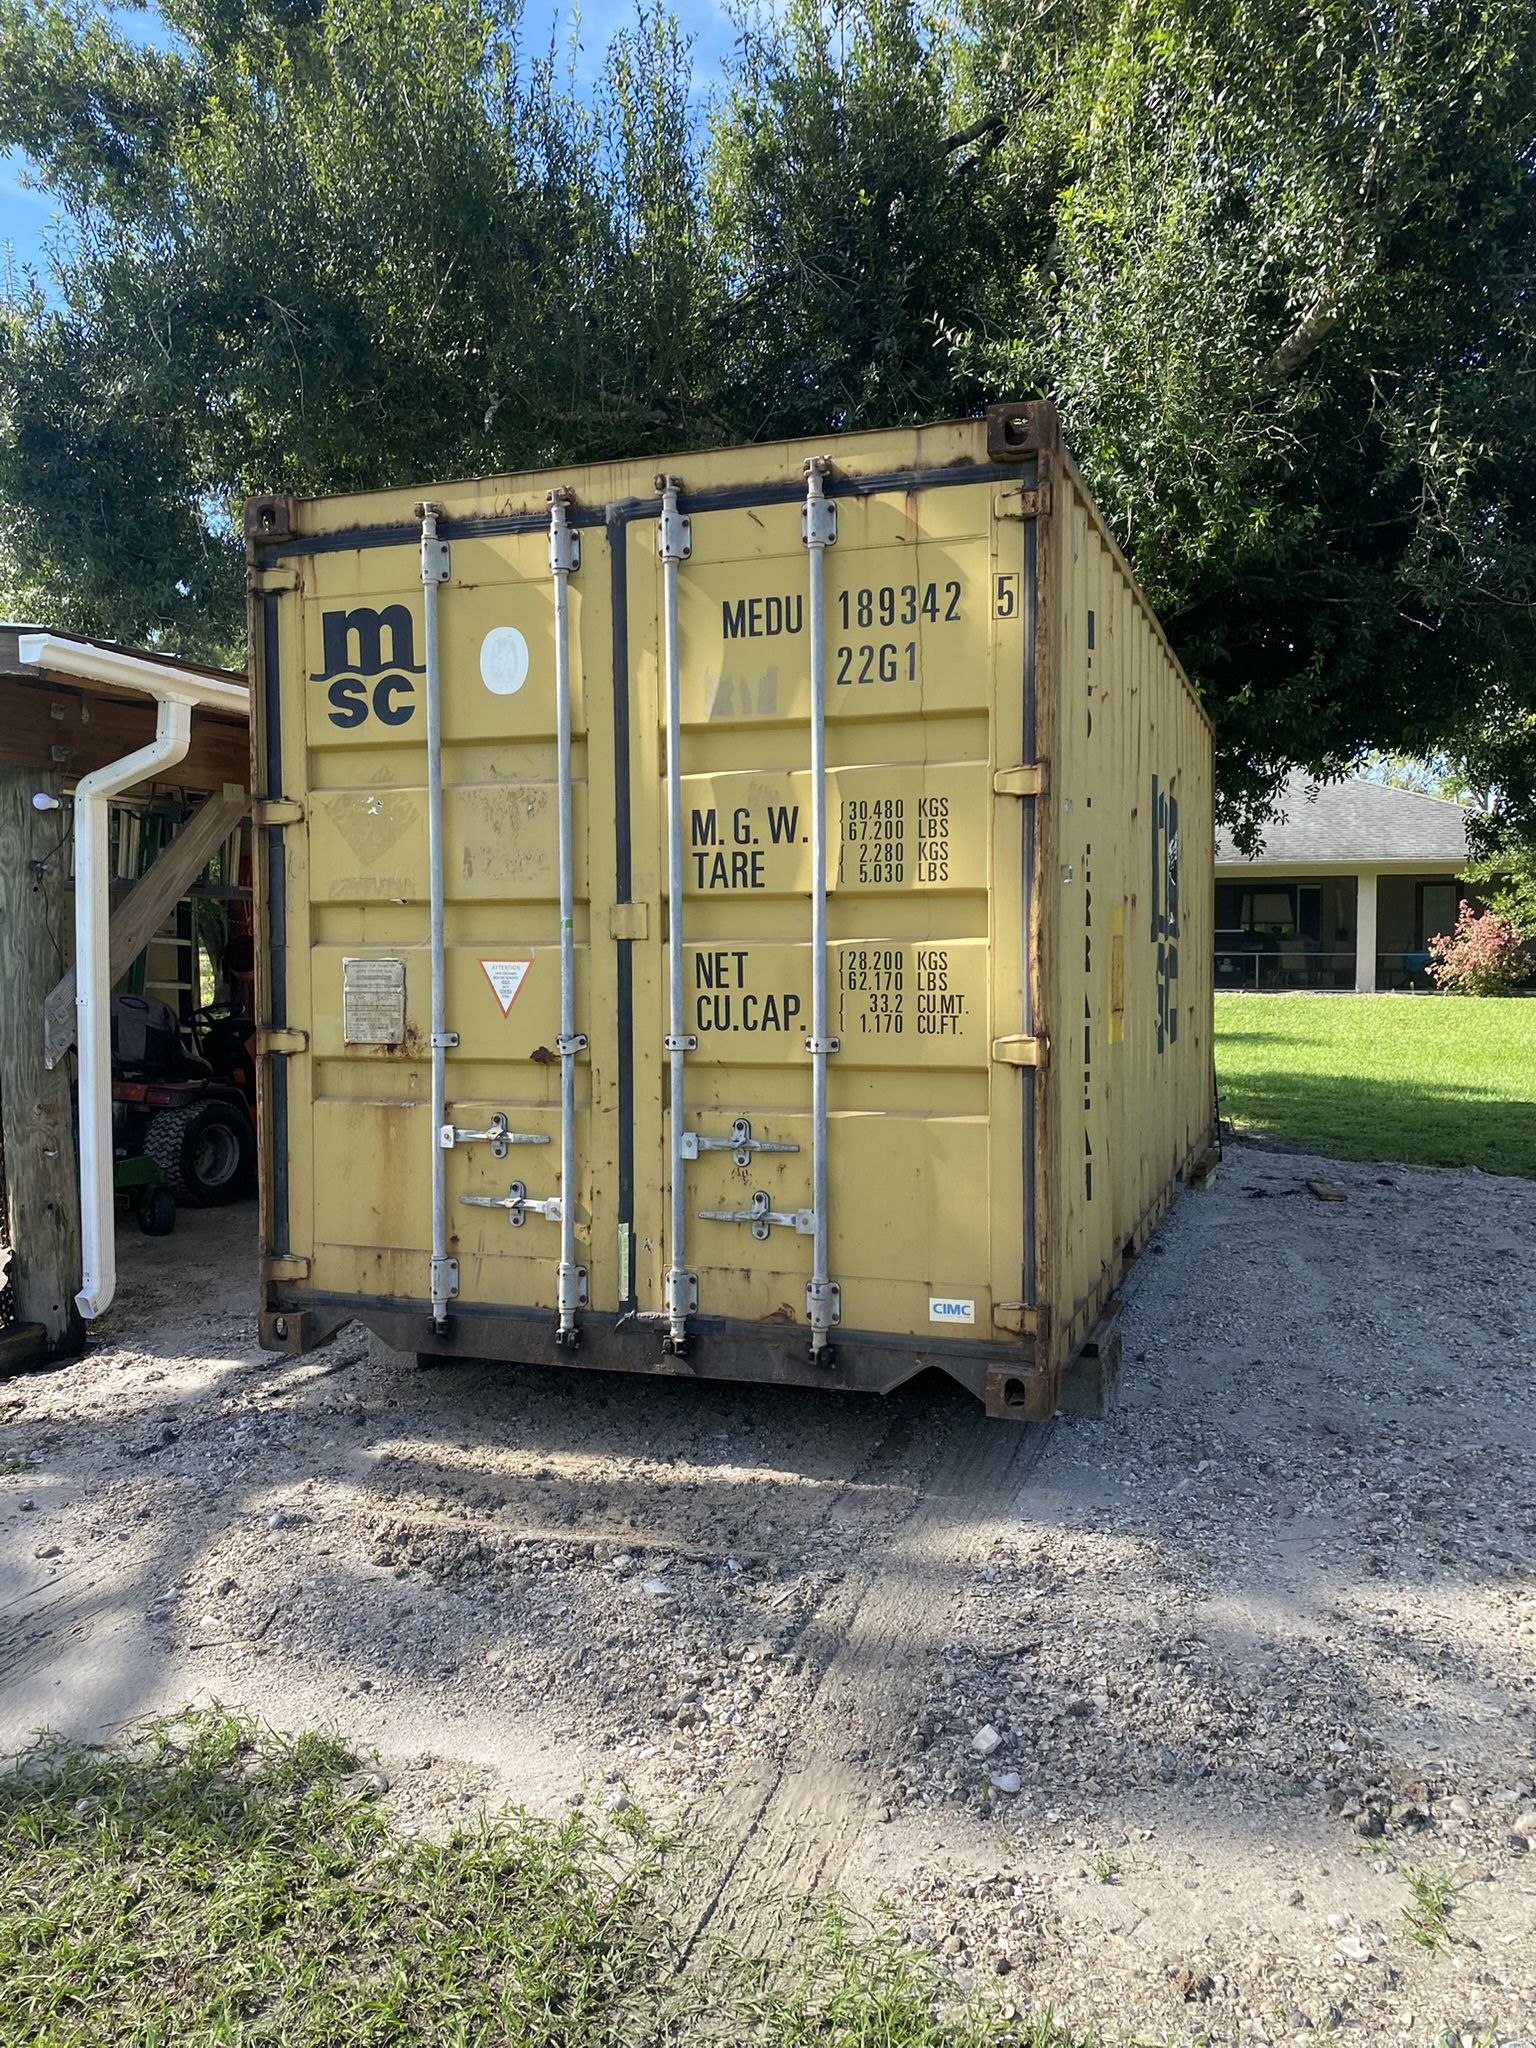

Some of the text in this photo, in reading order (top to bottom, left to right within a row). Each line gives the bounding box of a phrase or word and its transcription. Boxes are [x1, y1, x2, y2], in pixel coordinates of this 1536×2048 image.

[722, 576, 1014, 640] MEDU 189342 5
[836, 641, 916, 686] 22G1
[848, 797, 949, 820] 30,480 KGS
[848, 818, 949, 841] 67,200 LBS
[859, 840, 949, 863] 2,280 KGS
[691, 850, 766, 889] TARE
[859, 861, 949, 884] 5,030 LBS
[695, 951, 749, 989] NET
[848, 951, 948, 971] 28,200 KGS
[848, 971, 948, 992] 62,170 LBS
[696, 994, 807, 1032] CU.CAP.
[869, 993, 903, 1014] 33.2
[860, 1014, 903, 1034] 1,170
[932, 1303, 971, 1316] CIMC
